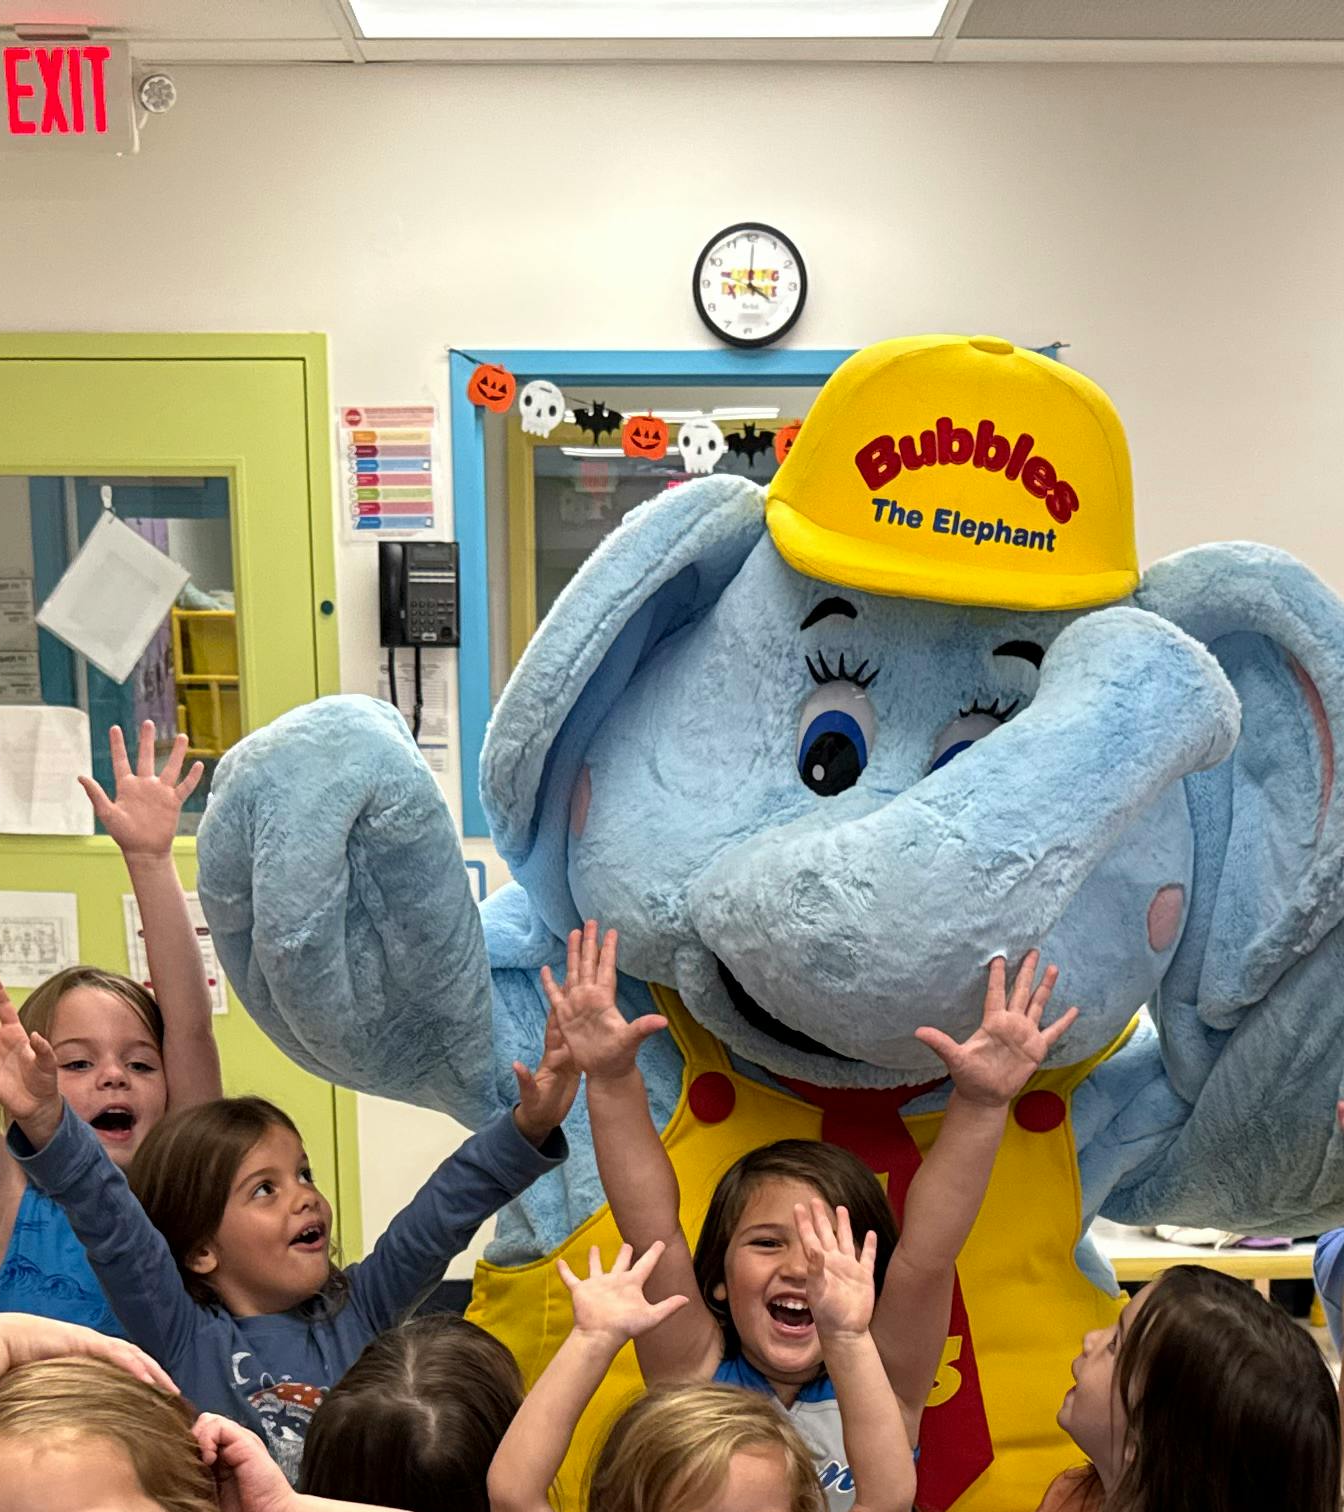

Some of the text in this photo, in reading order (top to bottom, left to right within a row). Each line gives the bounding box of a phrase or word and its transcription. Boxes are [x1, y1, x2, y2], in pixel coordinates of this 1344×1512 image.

[2, 46, 111, 135] EXIT
[855, 416, 1080, 524] Bubbles
[871, 497, 1057, 553] The Elephant
